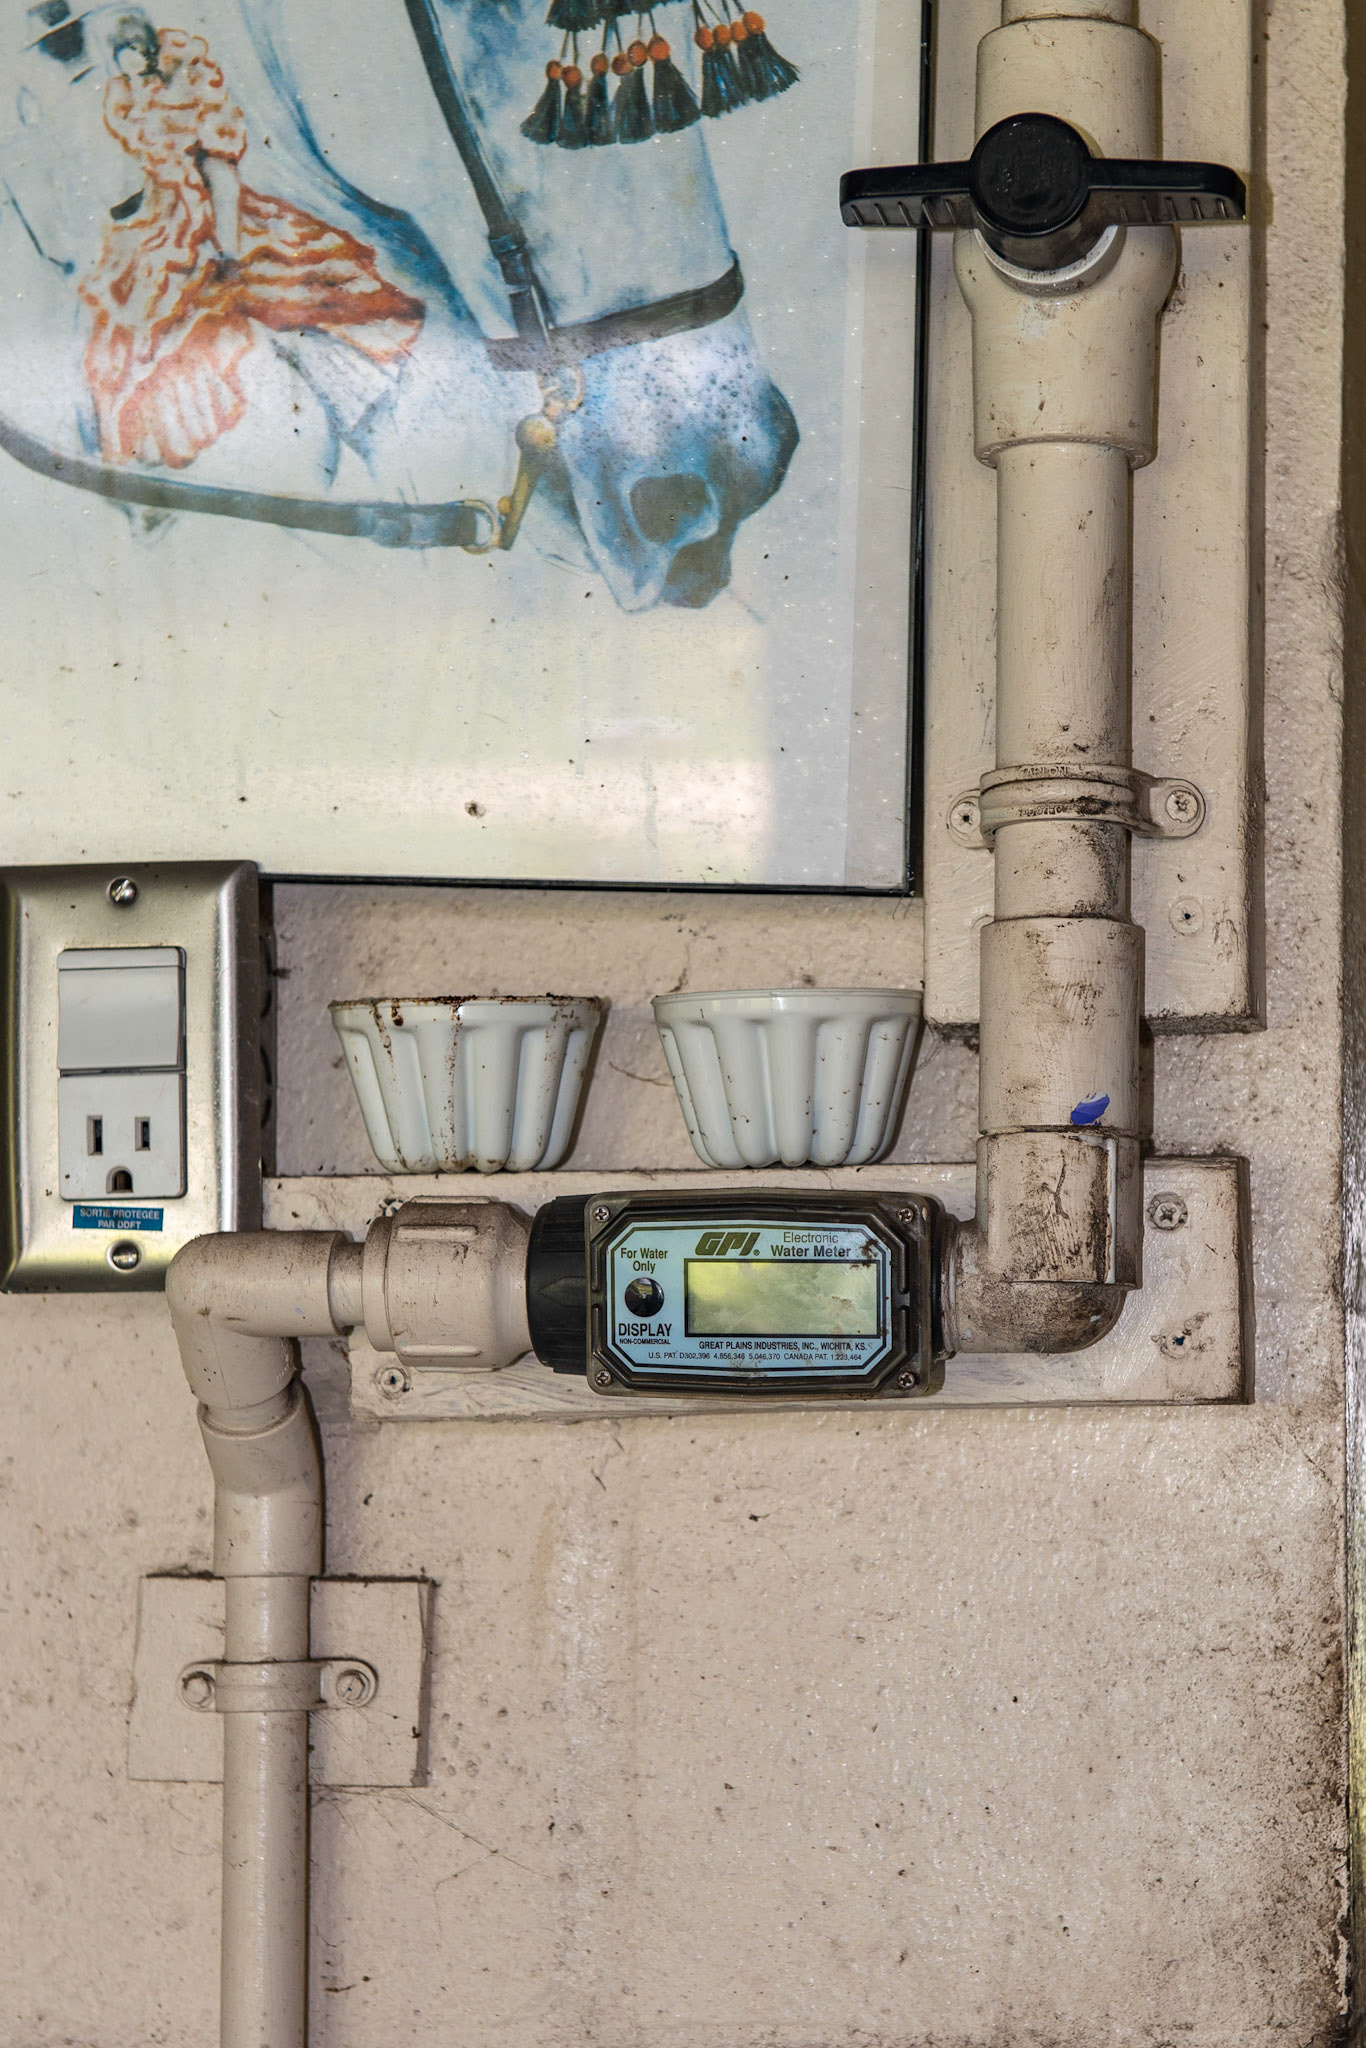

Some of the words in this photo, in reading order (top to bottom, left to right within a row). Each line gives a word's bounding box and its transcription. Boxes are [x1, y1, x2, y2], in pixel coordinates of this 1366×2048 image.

[98, 1219, 115, 1228] PAR
[783, 1232, 839, 1243] Electronic
[695, 1232, 760, 1256] GPI
[620, 1248, 639, 1259] For
[641, 1248, 668, 1259] Water
[771, 1245, 809, 1257] Water
[813, 1246, 851, 1257] Meter
[632, 1261, 656, 1274] Only
[618, 1323, 672, 1336] DISPLAY
[699, 1341, 724, 1350] GREAT
[726, 1341, 753, 1350] PLAINS
[754, 1341, 800, 1351] INDUSTRIES,
[801, 1342, 819, 1352] INC.,
[820, 1342, 853, 1352] WICHITA,
[855, 1343, 868, 1351] KS.
